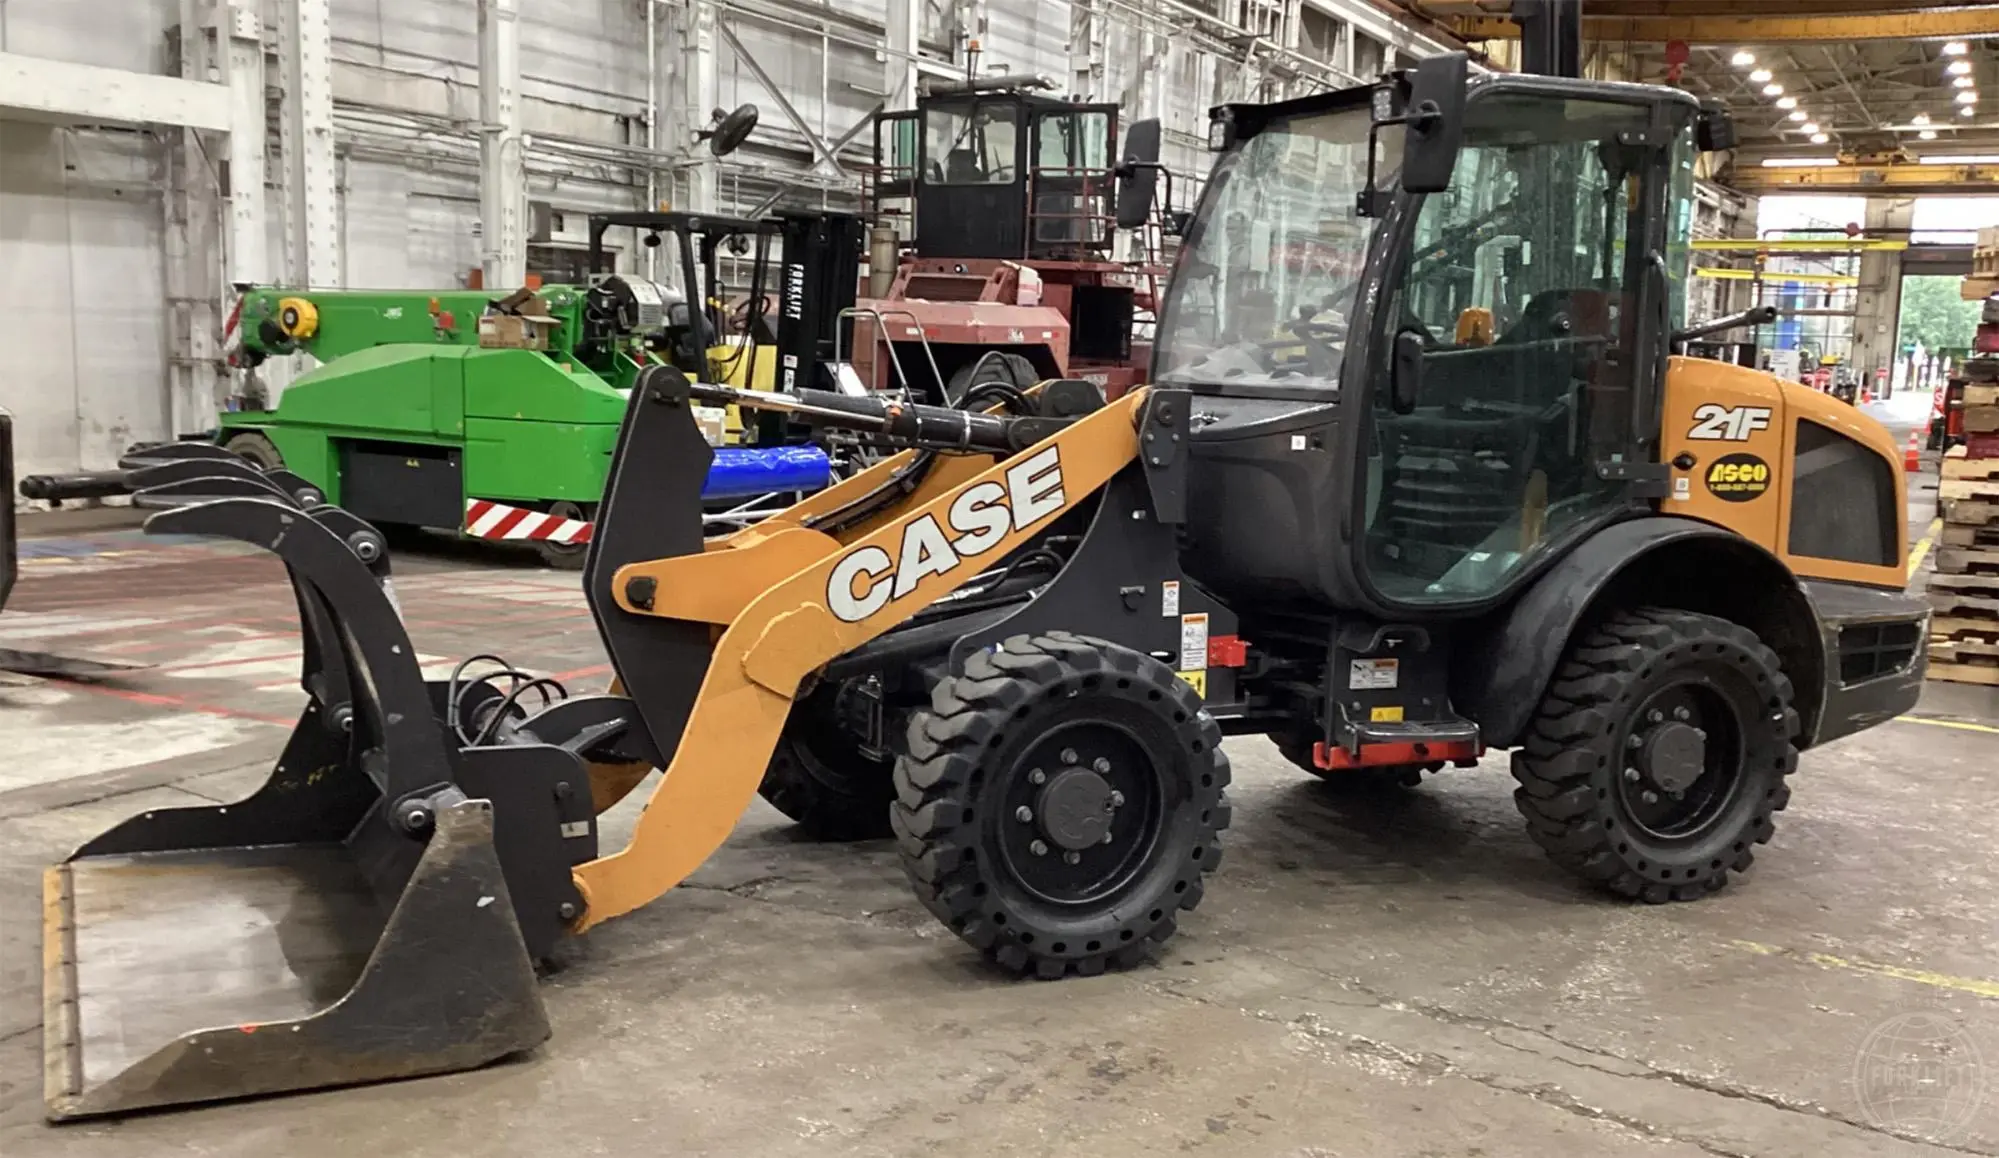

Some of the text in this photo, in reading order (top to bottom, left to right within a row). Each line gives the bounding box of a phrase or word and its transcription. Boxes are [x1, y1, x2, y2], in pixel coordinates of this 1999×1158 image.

[1686, 403, 1772, 442] 21F
[1709, 463, 1768, 482] ASCO
[827, 443, 1067, 623] CASE
